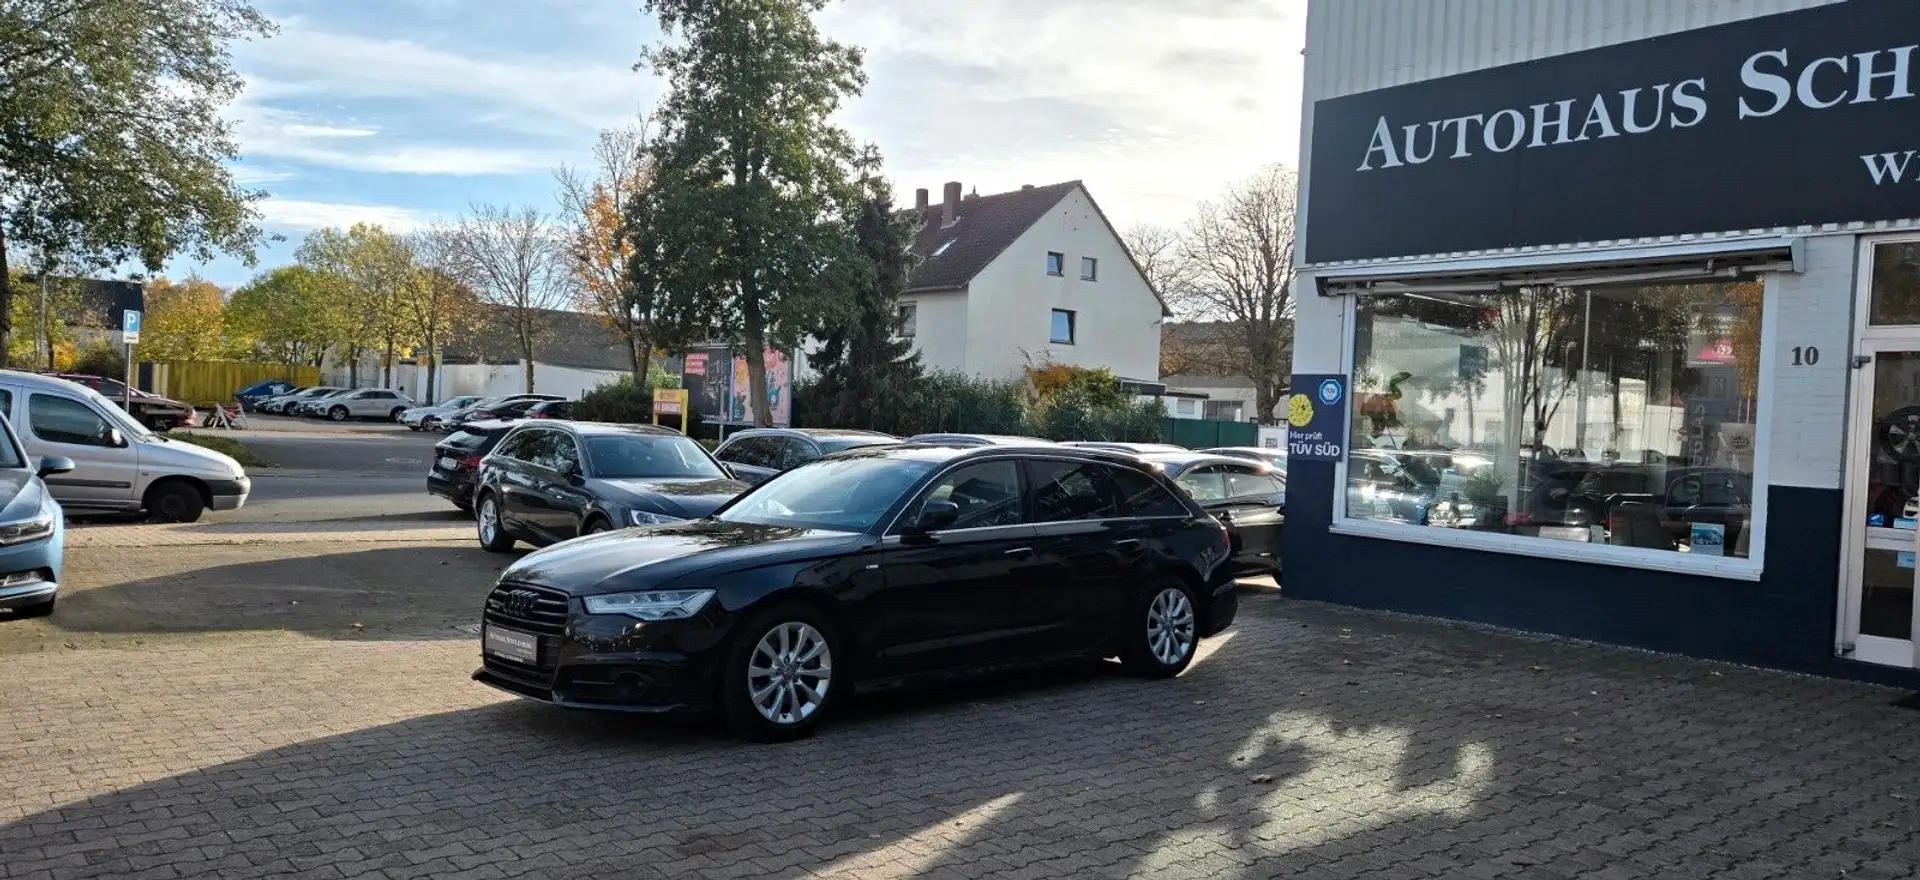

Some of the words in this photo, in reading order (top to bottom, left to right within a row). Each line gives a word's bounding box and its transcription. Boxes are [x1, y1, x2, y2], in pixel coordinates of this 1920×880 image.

[1356, 78, 1707, 172] AUTOHAUS
[126, 313, 136, 330] P
[1791, 346, 1820, 366] 10
[1289, 431, 1304, 439] Hier
[1289, 440, 1313, 455] TÜV
[1315, 441, 1340, 456] SÜD
